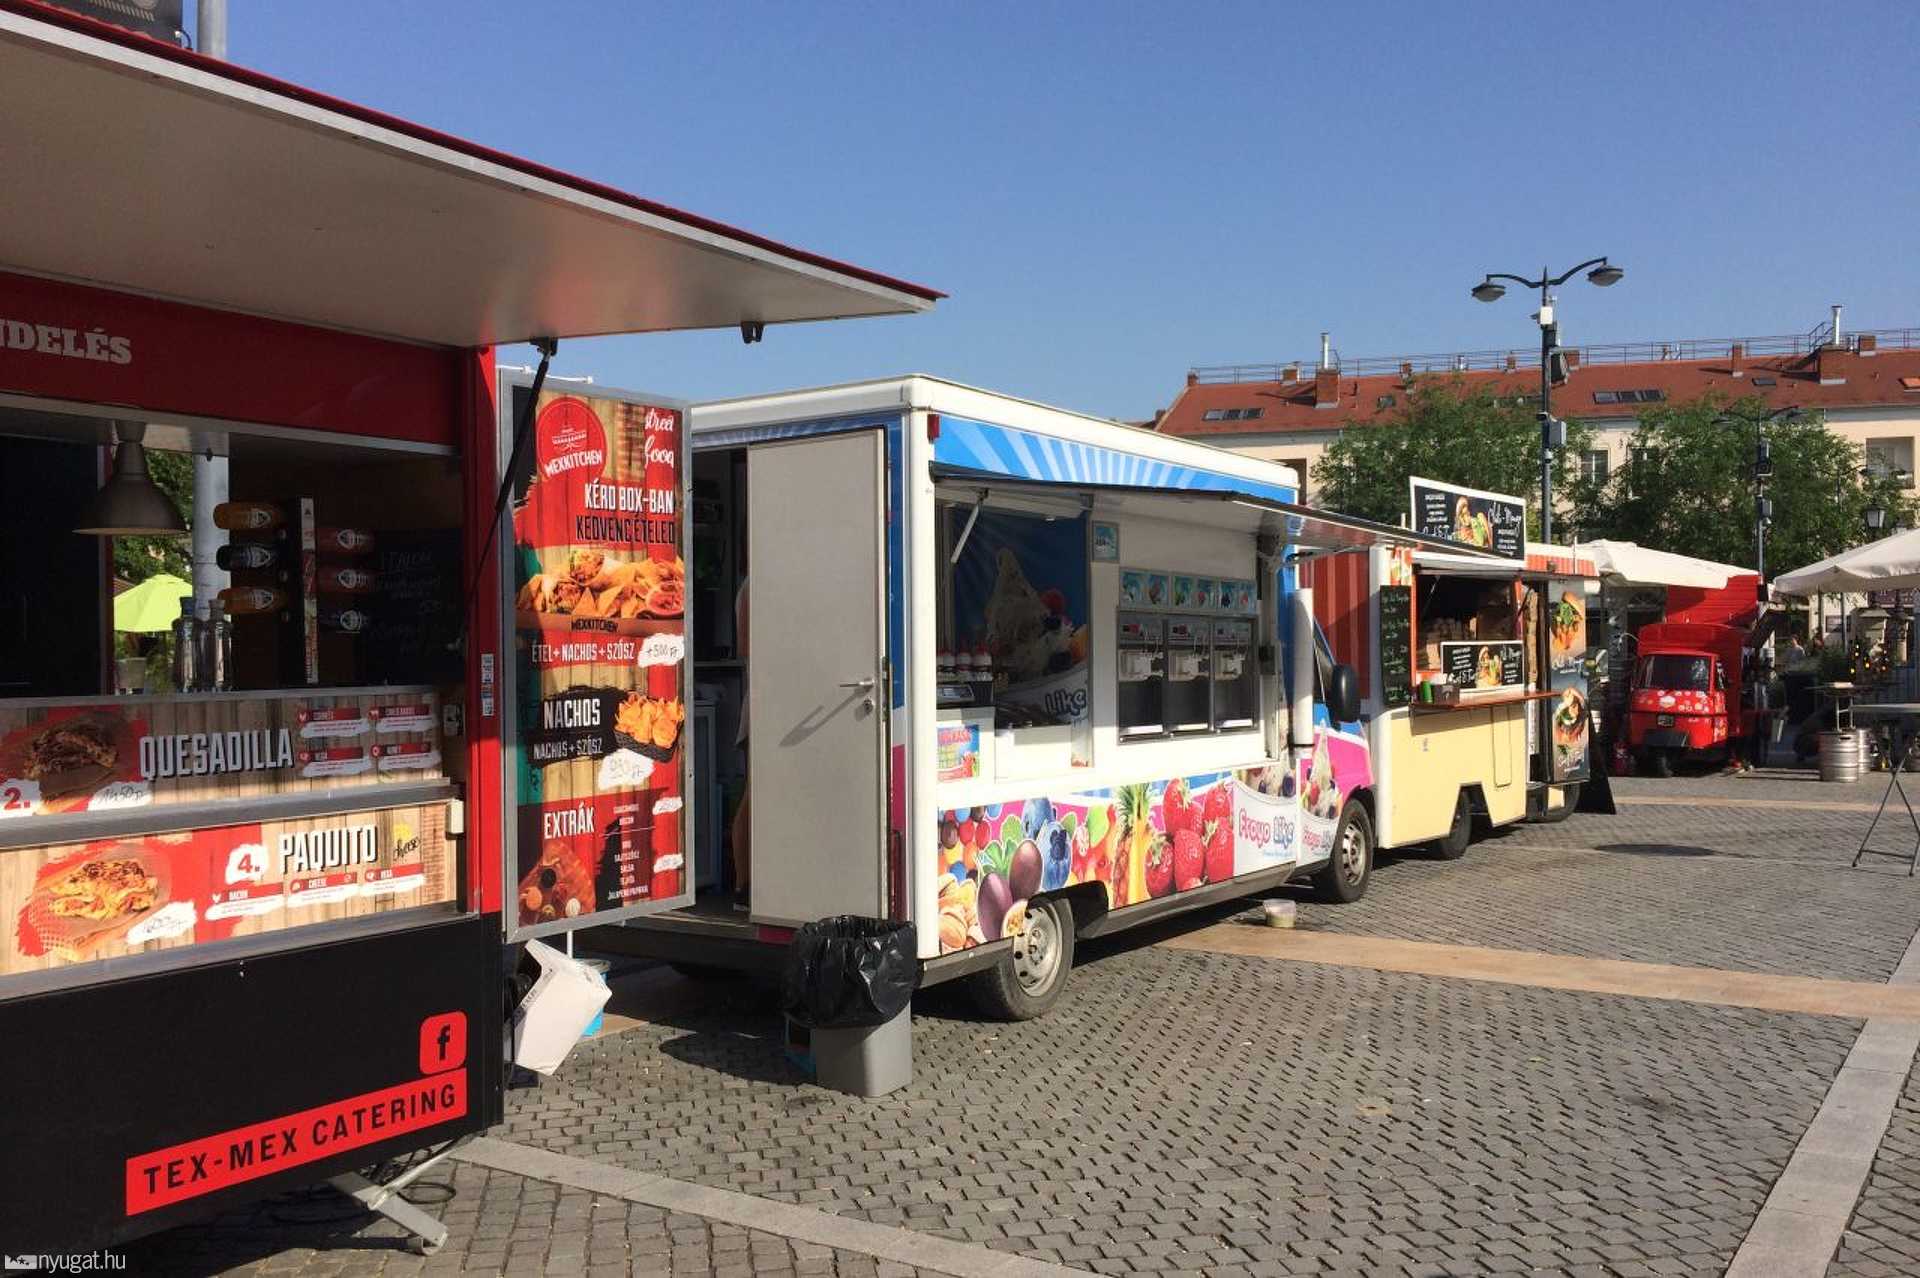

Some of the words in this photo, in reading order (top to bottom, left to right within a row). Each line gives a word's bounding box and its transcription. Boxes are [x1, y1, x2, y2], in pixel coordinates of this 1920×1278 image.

[561, 643, 597, 662] NACHOS
[607, 640, 635, 660] SZÓSZ
[544, 698, 601, 730] NACHOS
[139, 728, 293, 780] QUESADILLA
[533, 742, 568, 760] NACHOS
[577, 737, 603, 757] SZÓSZ
[544, 801, 595, 839] EXTRÁK
[1238, 808, 1271, 848] Froyo
[279, 824, 378, 874] PAQUITO
[143, 1127, 299, 1195] TEX-MEX
[311, 1082, 456, 1147] CATERING
